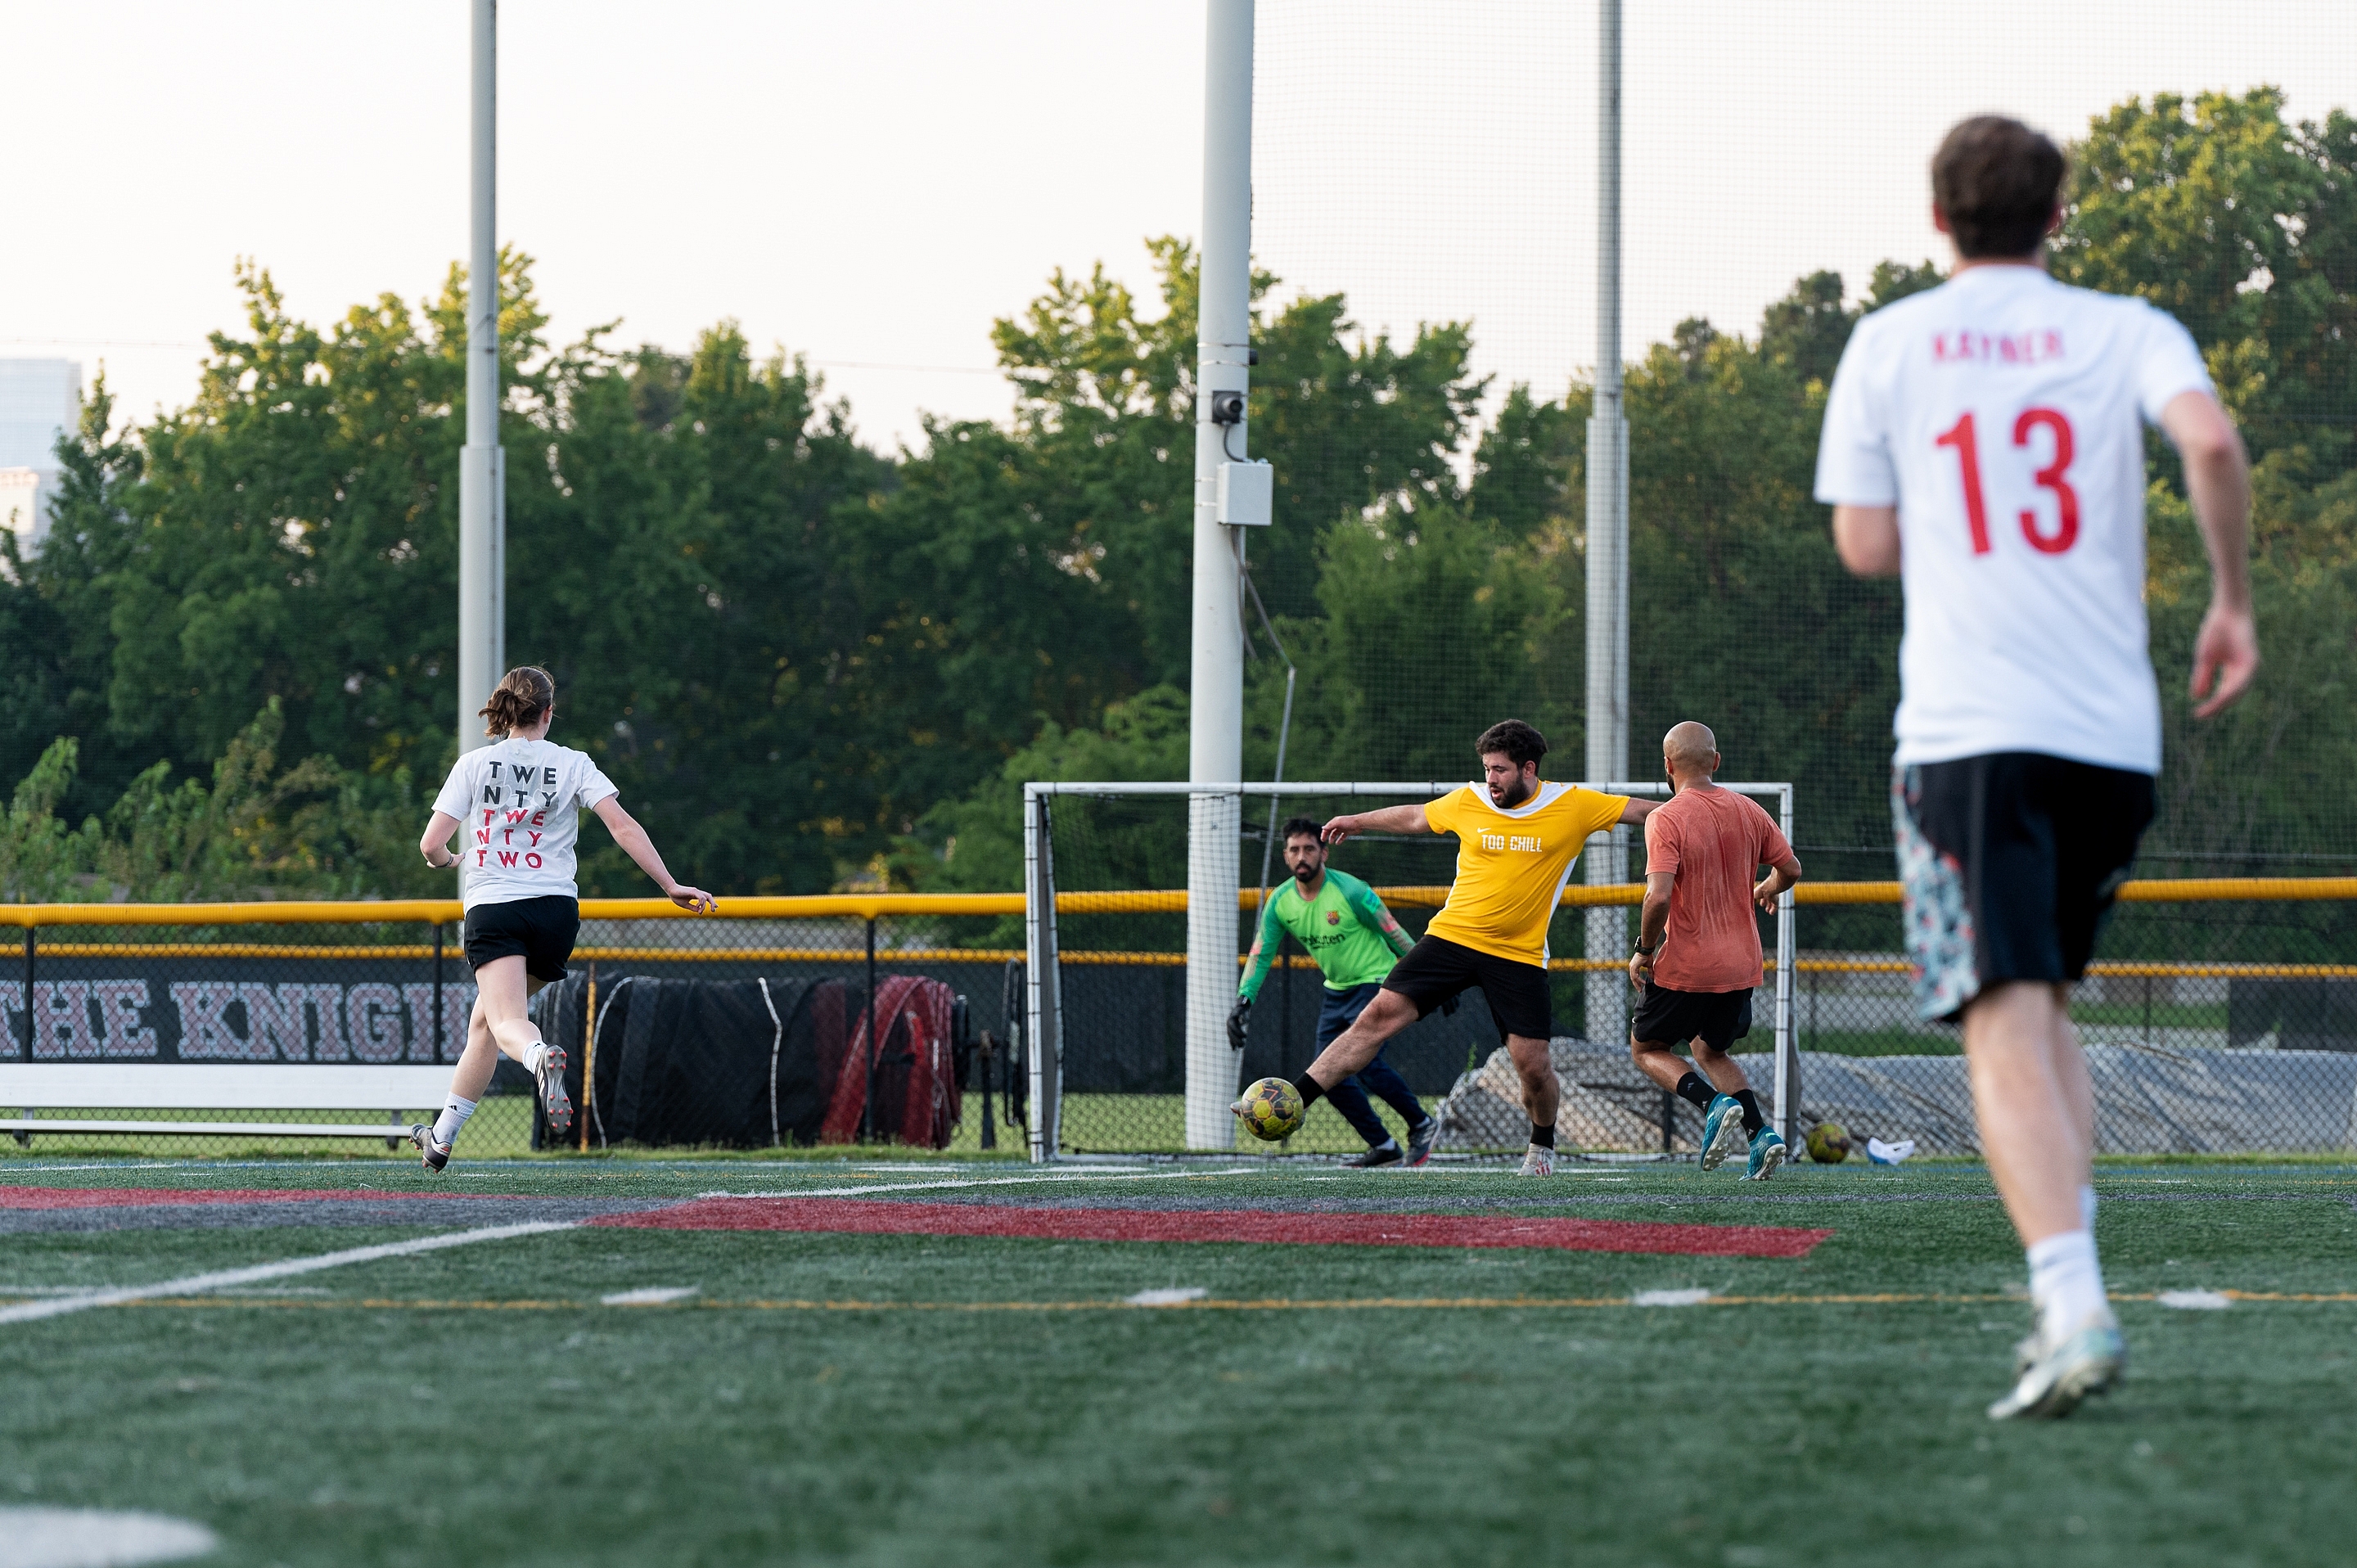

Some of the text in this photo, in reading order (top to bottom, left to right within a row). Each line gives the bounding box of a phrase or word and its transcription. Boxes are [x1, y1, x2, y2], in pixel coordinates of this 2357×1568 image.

[1936, 408, 2080, 555] 13
[489, 761, 557, 785] TWE
[484, 785, 557, 808] NTY
[483, 809, 548, 827] TWE
[476, 828, 543, 847] NTY
[1481, 835, 1542, 852] TOO CHILL
[476, 849, 543, 868] TWO
[169, 981, 536, 1063] KNIGH
